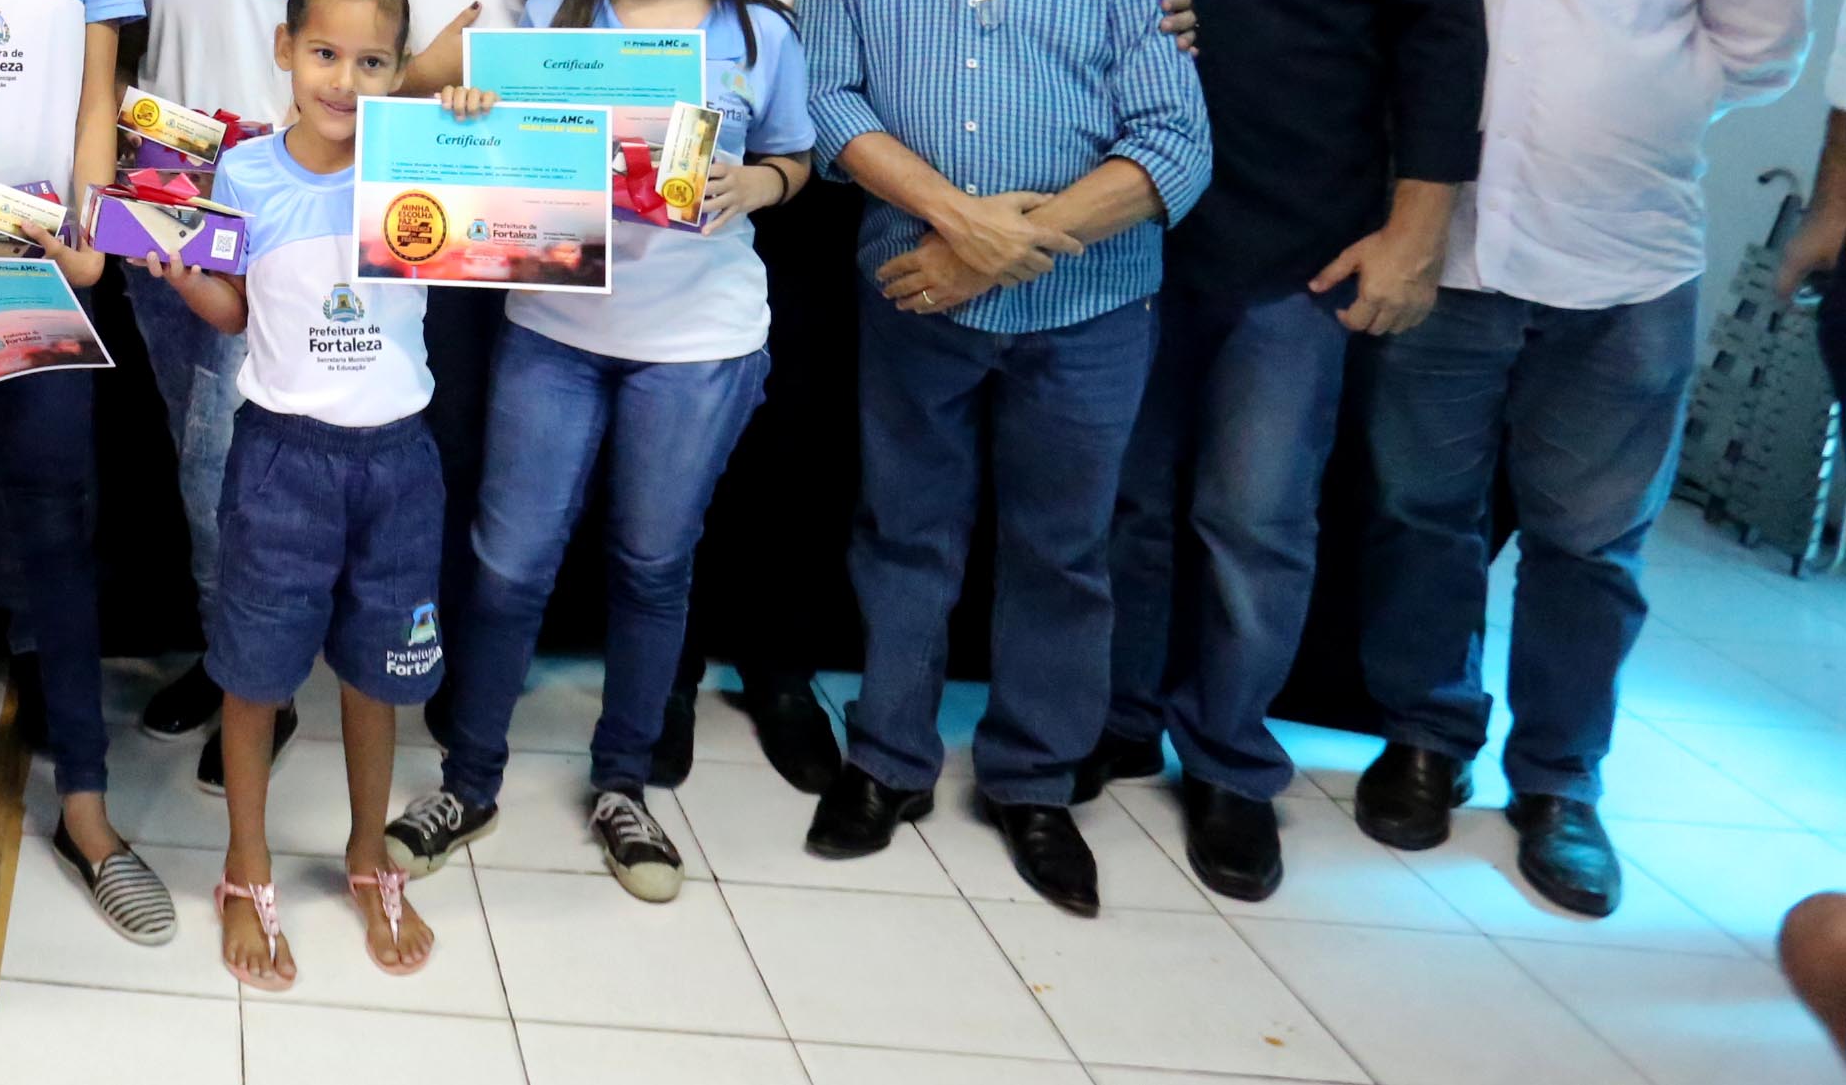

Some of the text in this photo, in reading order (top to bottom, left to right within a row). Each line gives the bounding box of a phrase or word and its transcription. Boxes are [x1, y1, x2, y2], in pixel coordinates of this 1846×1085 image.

[11, 49, 23, 57] de
[543, 59, 604, 71] Certificado
[560, 115, 583, 124] AMC
[436, 133, 501, 147] Certificado
[493, 230, 537, 239] Fortaleza
[309, 324, 380, 336] Prefeitura de
[309, 337, 382, 353] Fortaleza
